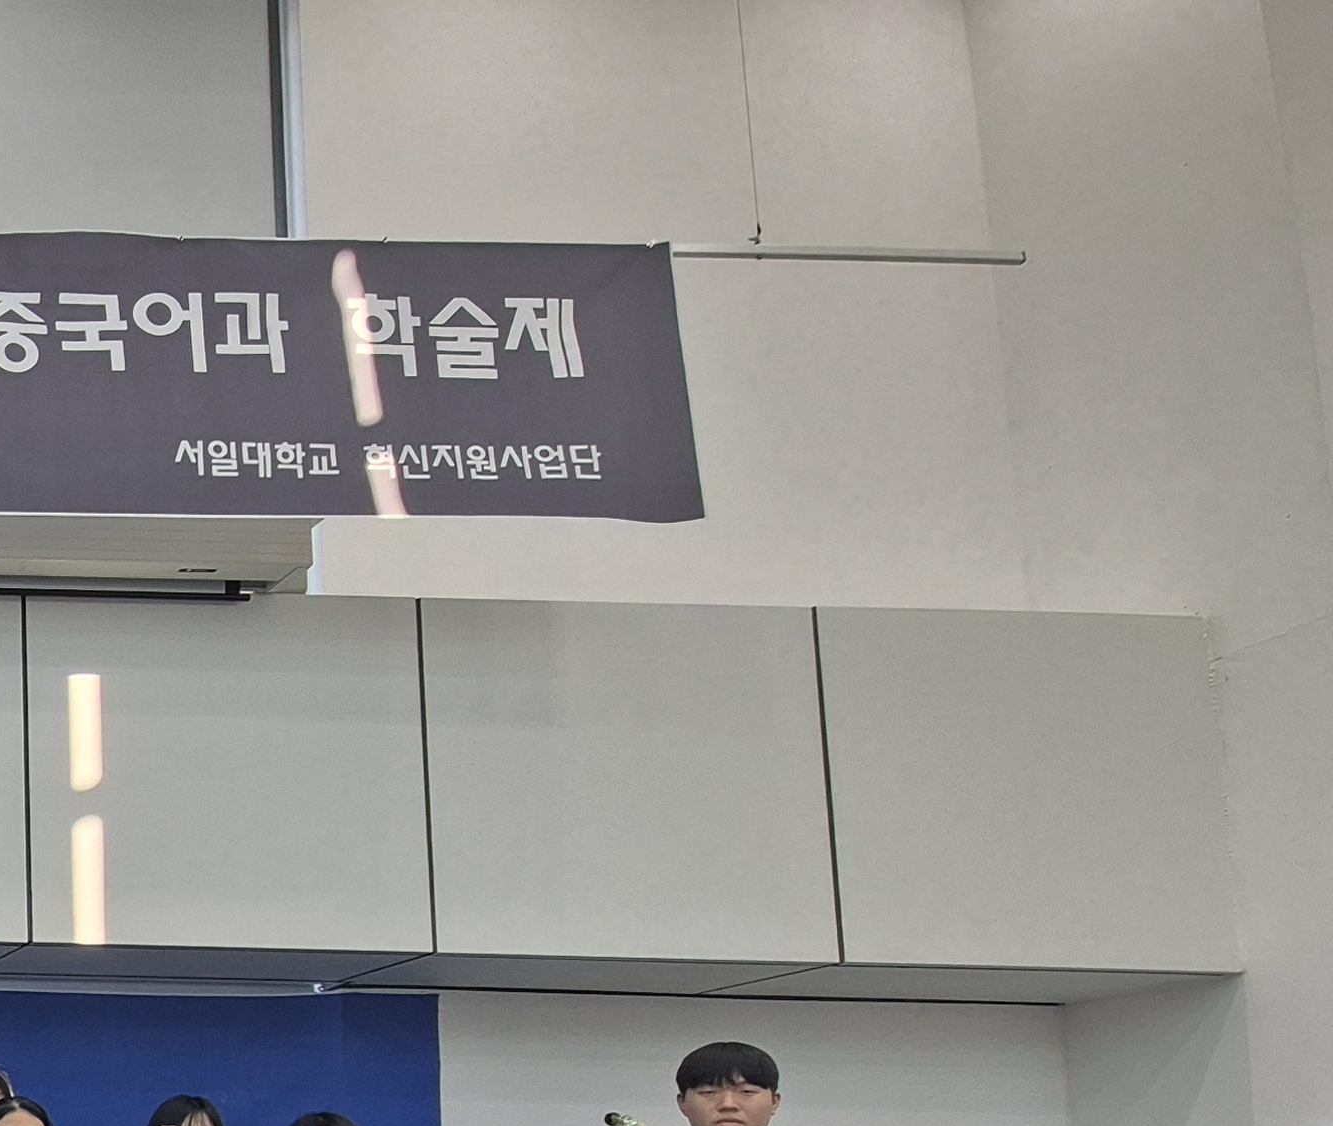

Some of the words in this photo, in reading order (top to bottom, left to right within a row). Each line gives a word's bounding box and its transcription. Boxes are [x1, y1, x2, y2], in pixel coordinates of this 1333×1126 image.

[347, 293, 585, 380] 학술제
[174, 439, 340, 479] 서일대학교
[363, 443, 602, 480] 혁신지원사업단
